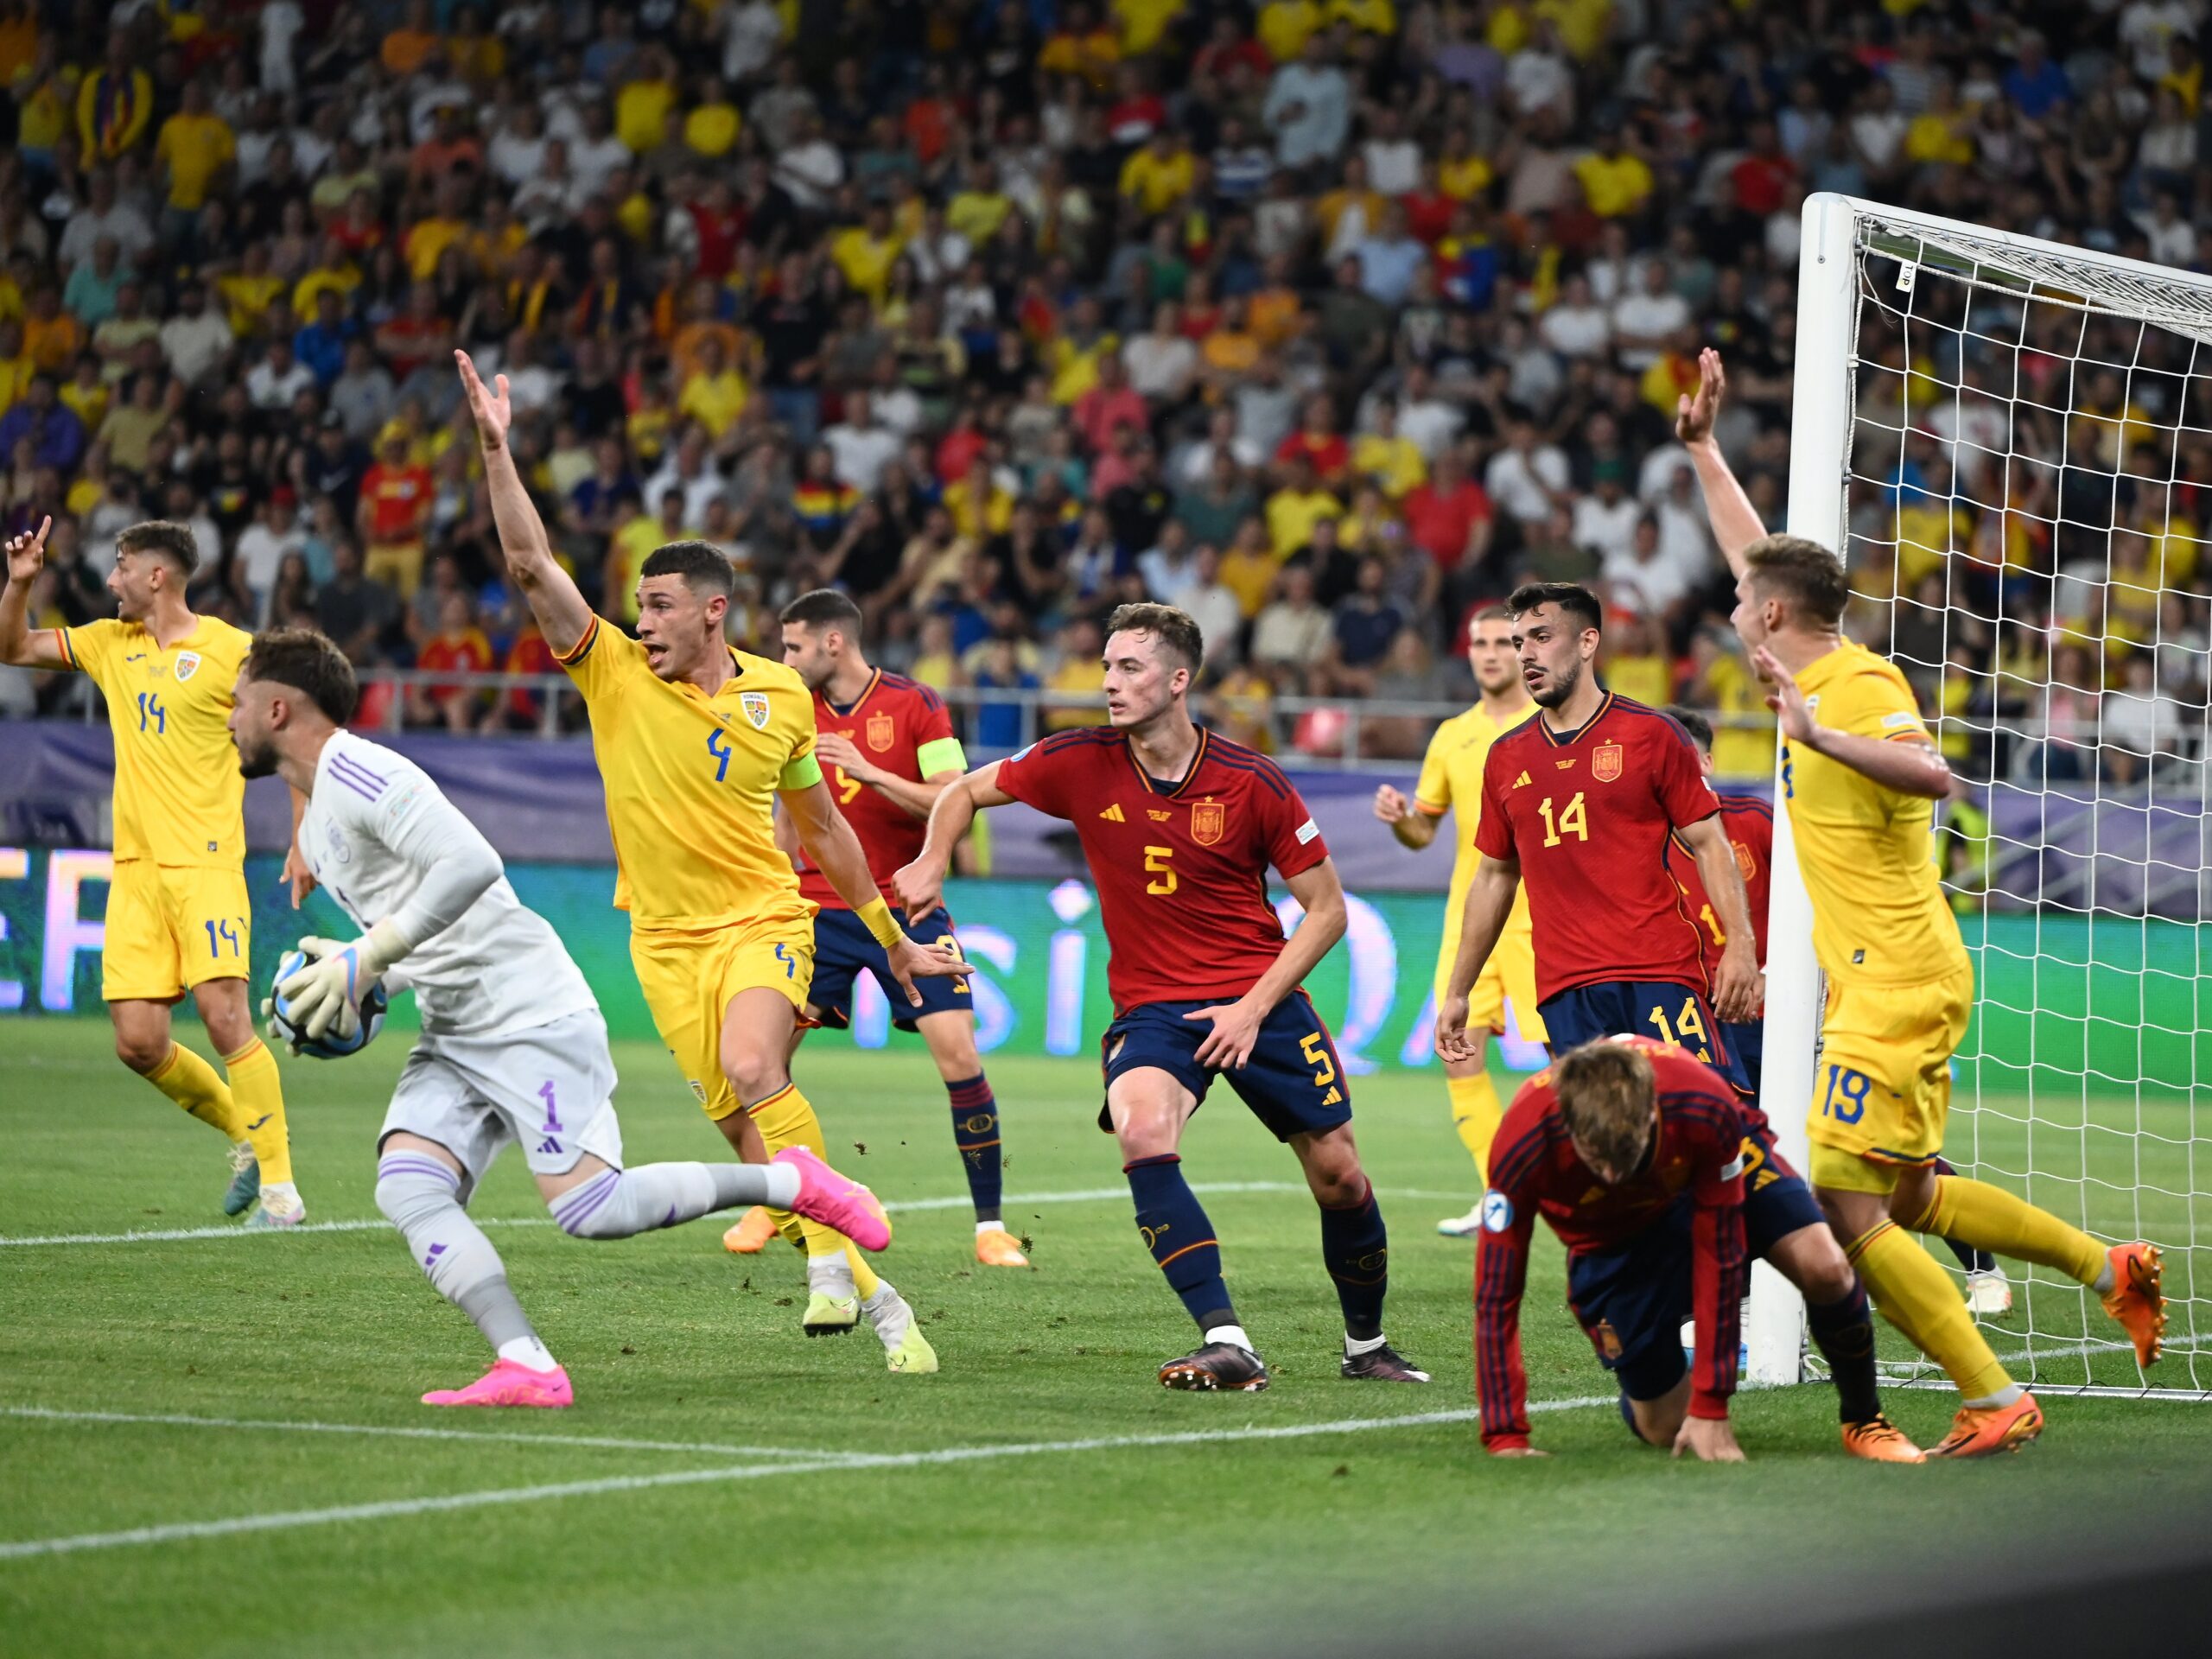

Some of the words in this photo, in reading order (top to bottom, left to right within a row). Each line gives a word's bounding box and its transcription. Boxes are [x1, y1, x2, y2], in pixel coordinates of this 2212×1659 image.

[1902, 265, 1914, 286] TOP
[138, 692, 165, 734] 14
[707, 728, 732, 782] 4
[1537, 791, 1589, 848] 14
[1144, 845, 1178, 895] 5
[205, 918, 239, 957] 14
[774, 942, 795, 979] 4
[1649, 996, 1707, 1047] 14
[1299, 1031, 1335, 1087] 5
[537, 1080, 563, 1132] 1
[1822, 1064, 1872, 1125] 19
